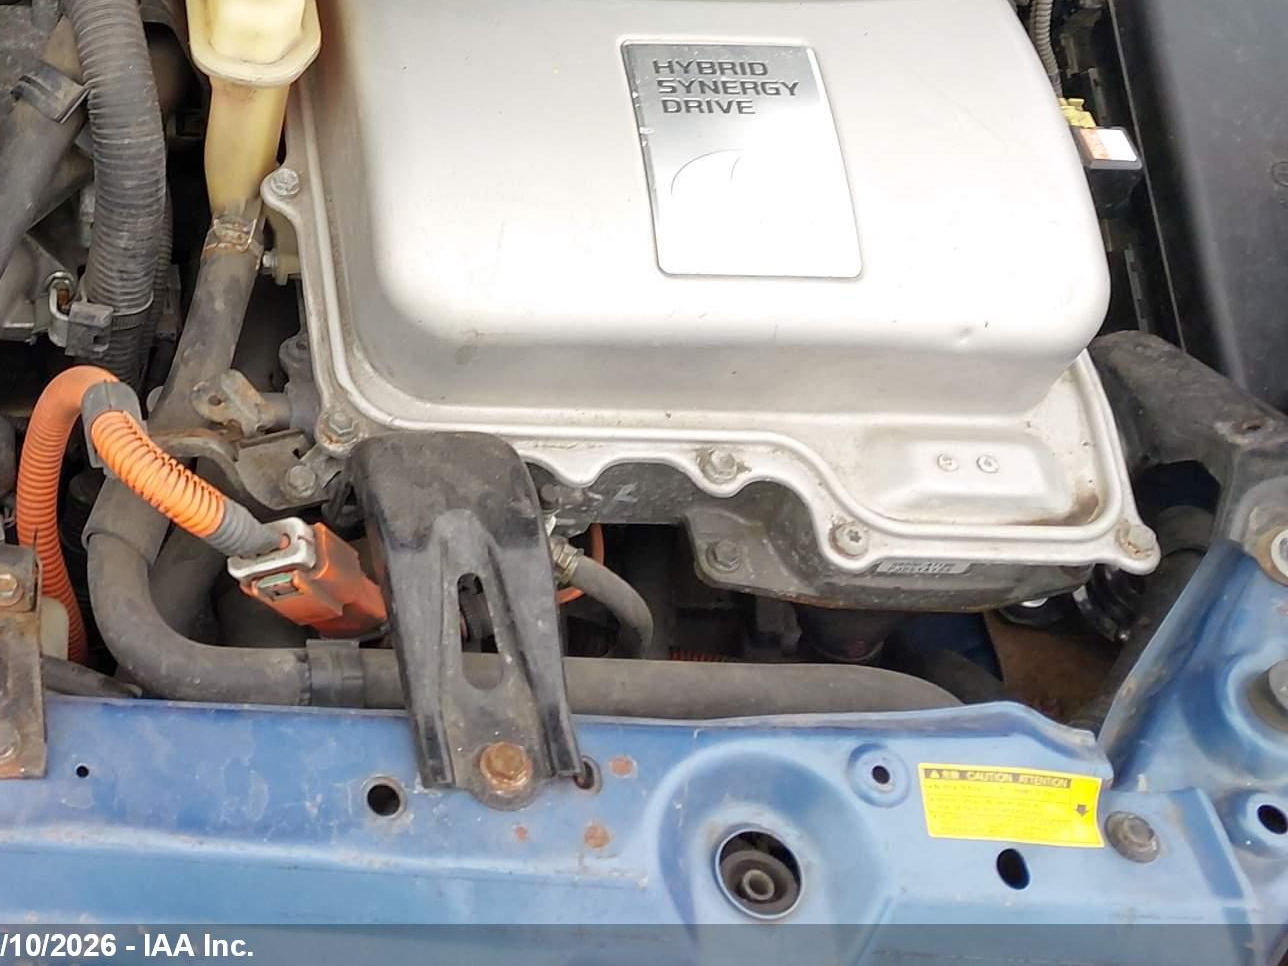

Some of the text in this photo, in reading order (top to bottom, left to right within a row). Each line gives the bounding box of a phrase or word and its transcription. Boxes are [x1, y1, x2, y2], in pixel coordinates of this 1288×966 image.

[652, 59, 769, 76] HYBRID
[656, 78, 800, 96] SYNERGY
[661, 98, 756, 115] DRIVE
[966, 771, 1013, 783] CAUTION
[1017, 774, 1069, 788] ATTENTION
